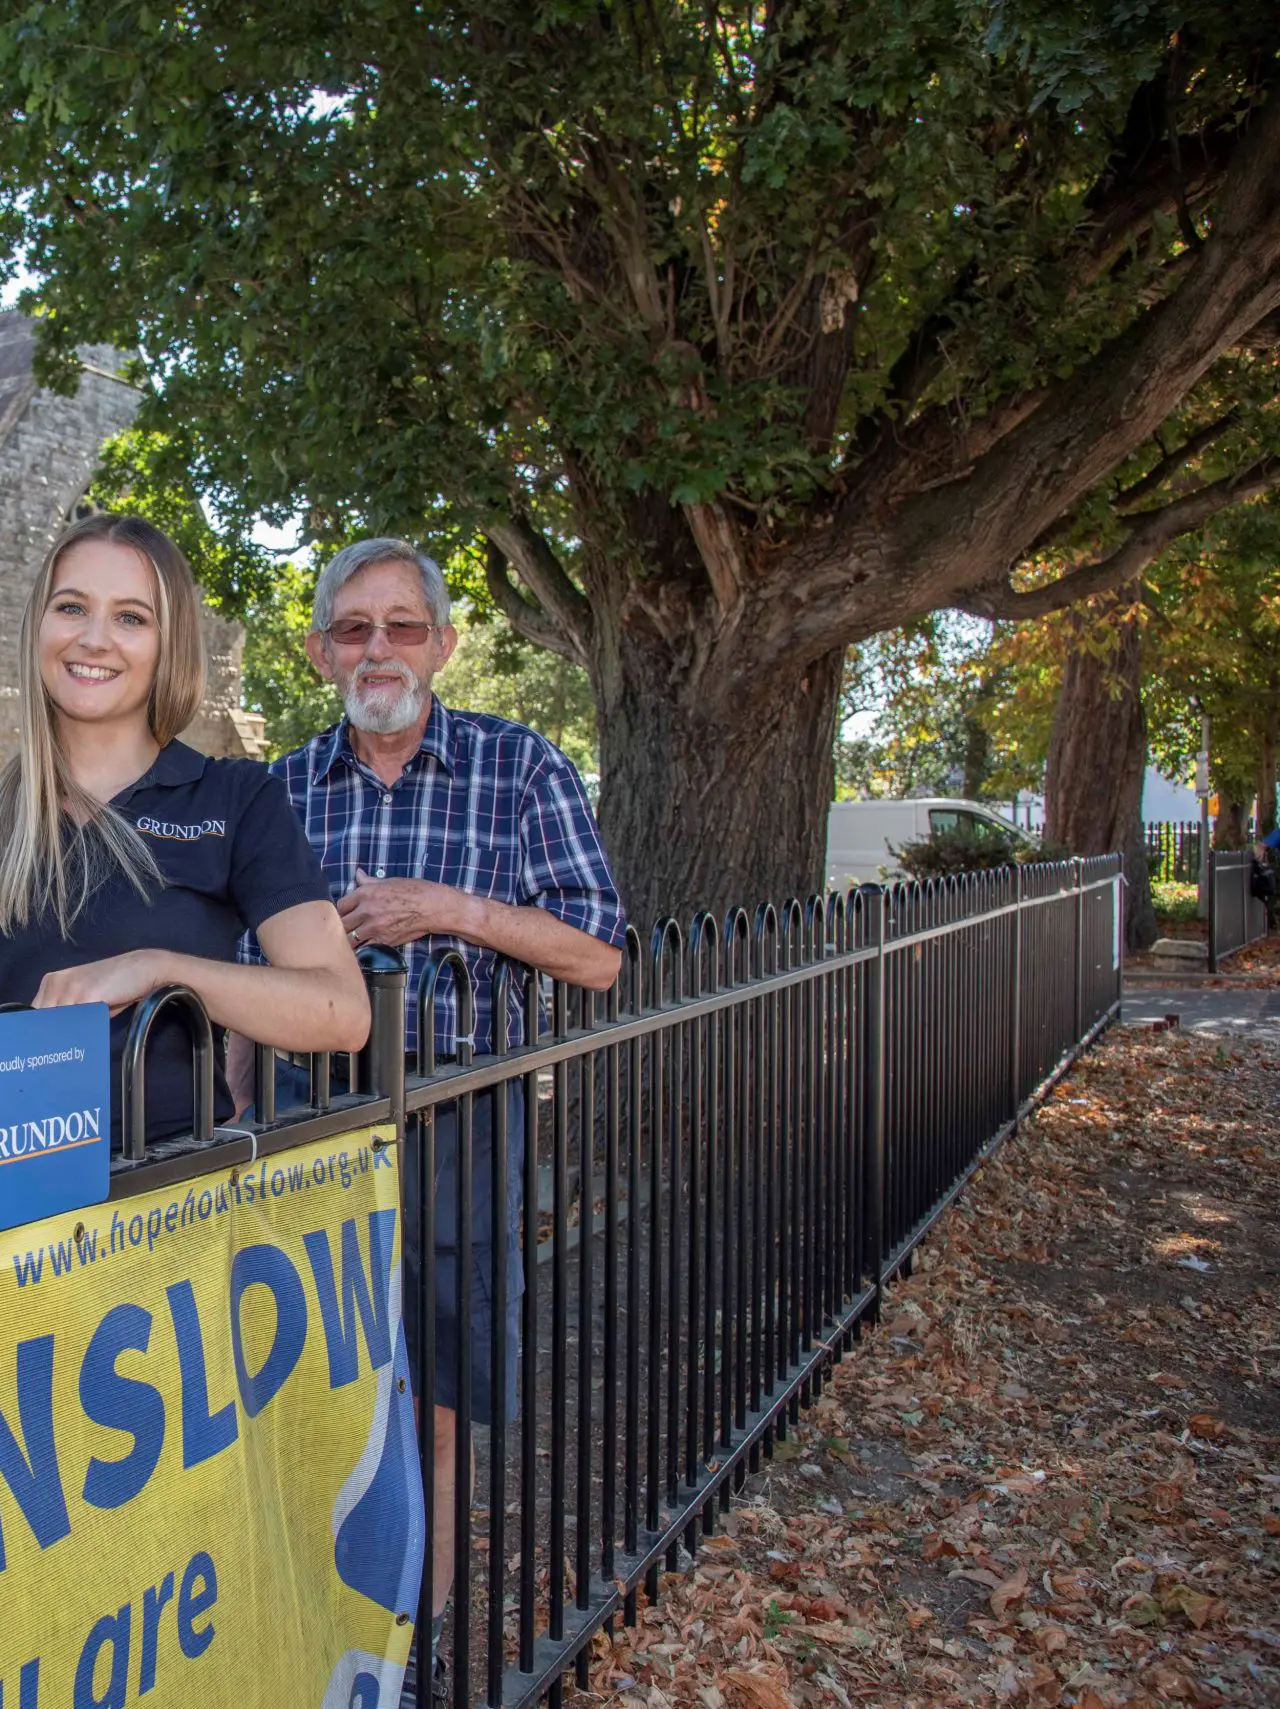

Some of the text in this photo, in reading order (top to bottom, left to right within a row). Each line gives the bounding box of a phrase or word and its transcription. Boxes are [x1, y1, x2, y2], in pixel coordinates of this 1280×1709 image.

[136, 816, 226, 839] GRUNDON
[27, 1047, 73, 1070] sponsored
[74, 1047, 85, 1061] by
[12, 1138, 393, 1288] www.hopehounslow.org.uk
[73, 1551, 218, 1709] are
